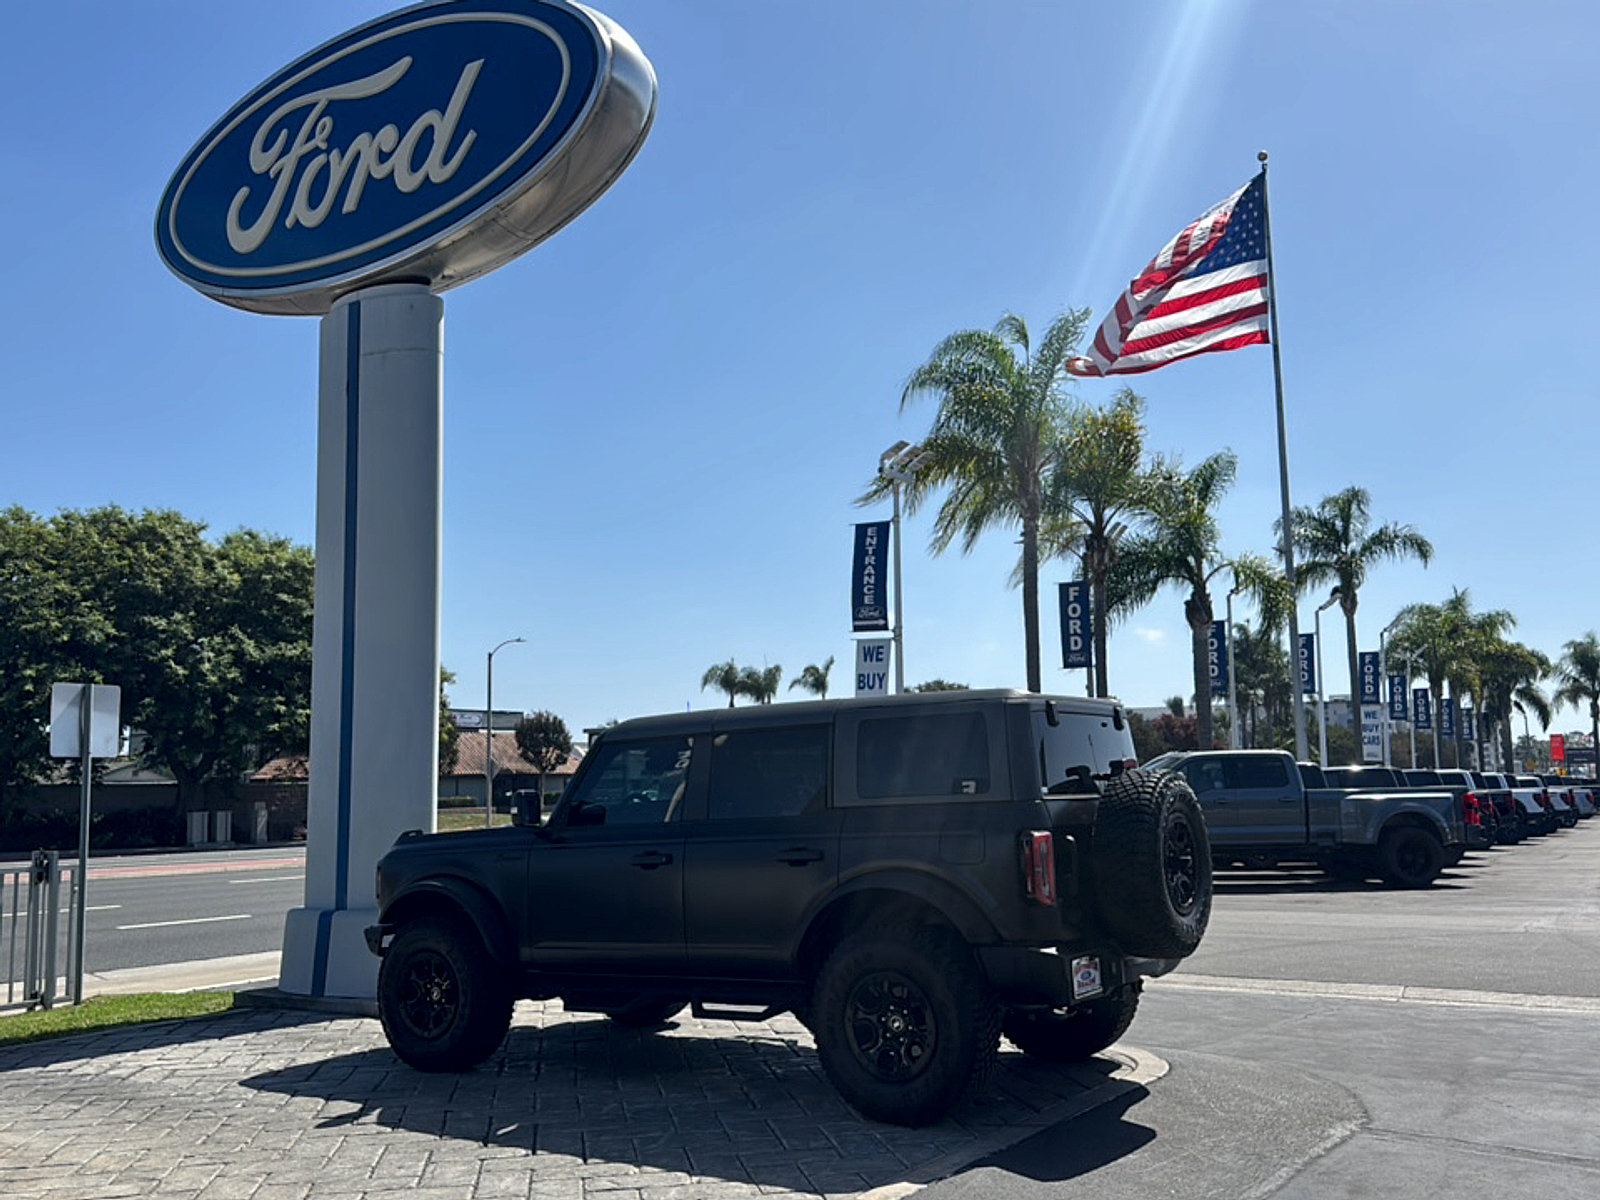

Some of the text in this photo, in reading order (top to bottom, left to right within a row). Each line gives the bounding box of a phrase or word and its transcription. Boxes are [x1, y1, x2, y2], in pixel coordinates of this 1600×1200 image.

[226, 55, 485, 255] Ford
[863, 526, 877, 604] ENTRANCE
[1067, 586, 1083, 651] FORD
[862, 645, 885, 663] WE
[1209, 625, 1218, 678] FORD
[1299, 637, 1308, 681] FORD
[857, 672, 886, 691] BUY
[1364, 655, 1374, 694] FORD
[1394, 677, 1403, 711] FORD
[1364, 711, 1377, 719] WE
